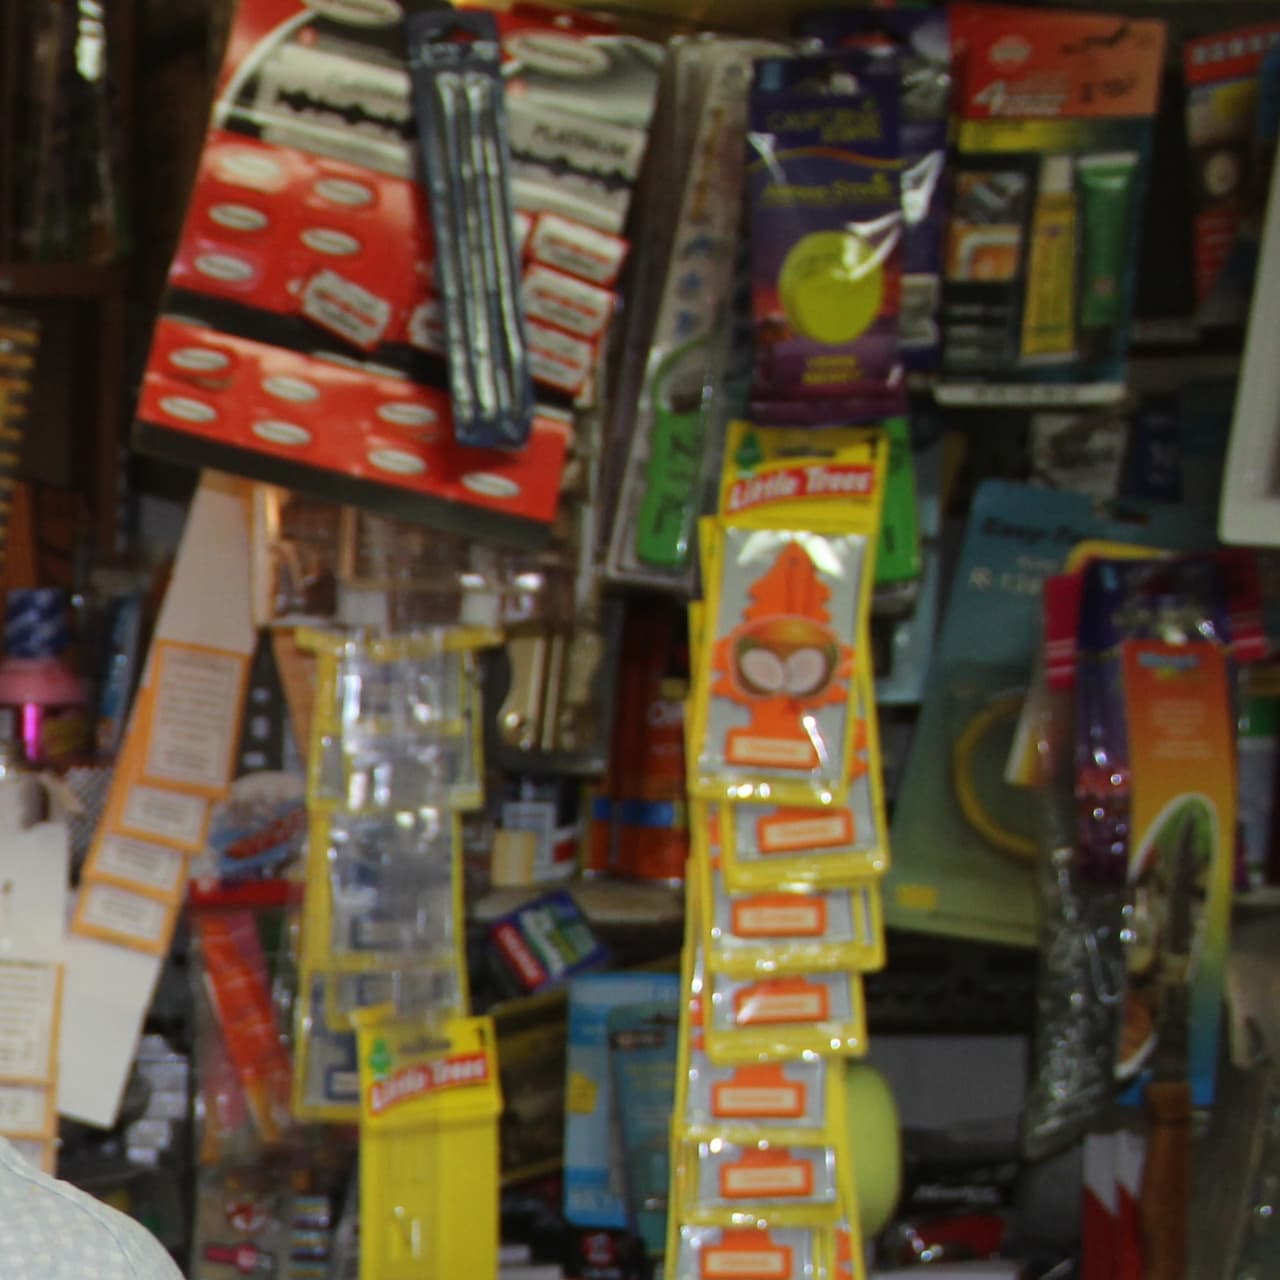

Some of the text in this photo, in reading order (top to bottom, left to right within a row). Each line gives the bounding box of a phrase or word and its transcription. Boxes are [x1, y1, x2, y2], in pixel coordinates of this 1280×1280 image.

[729, 465, 872, 512] Little Trees
[372, 1056, 487, 1112] Little Trees
